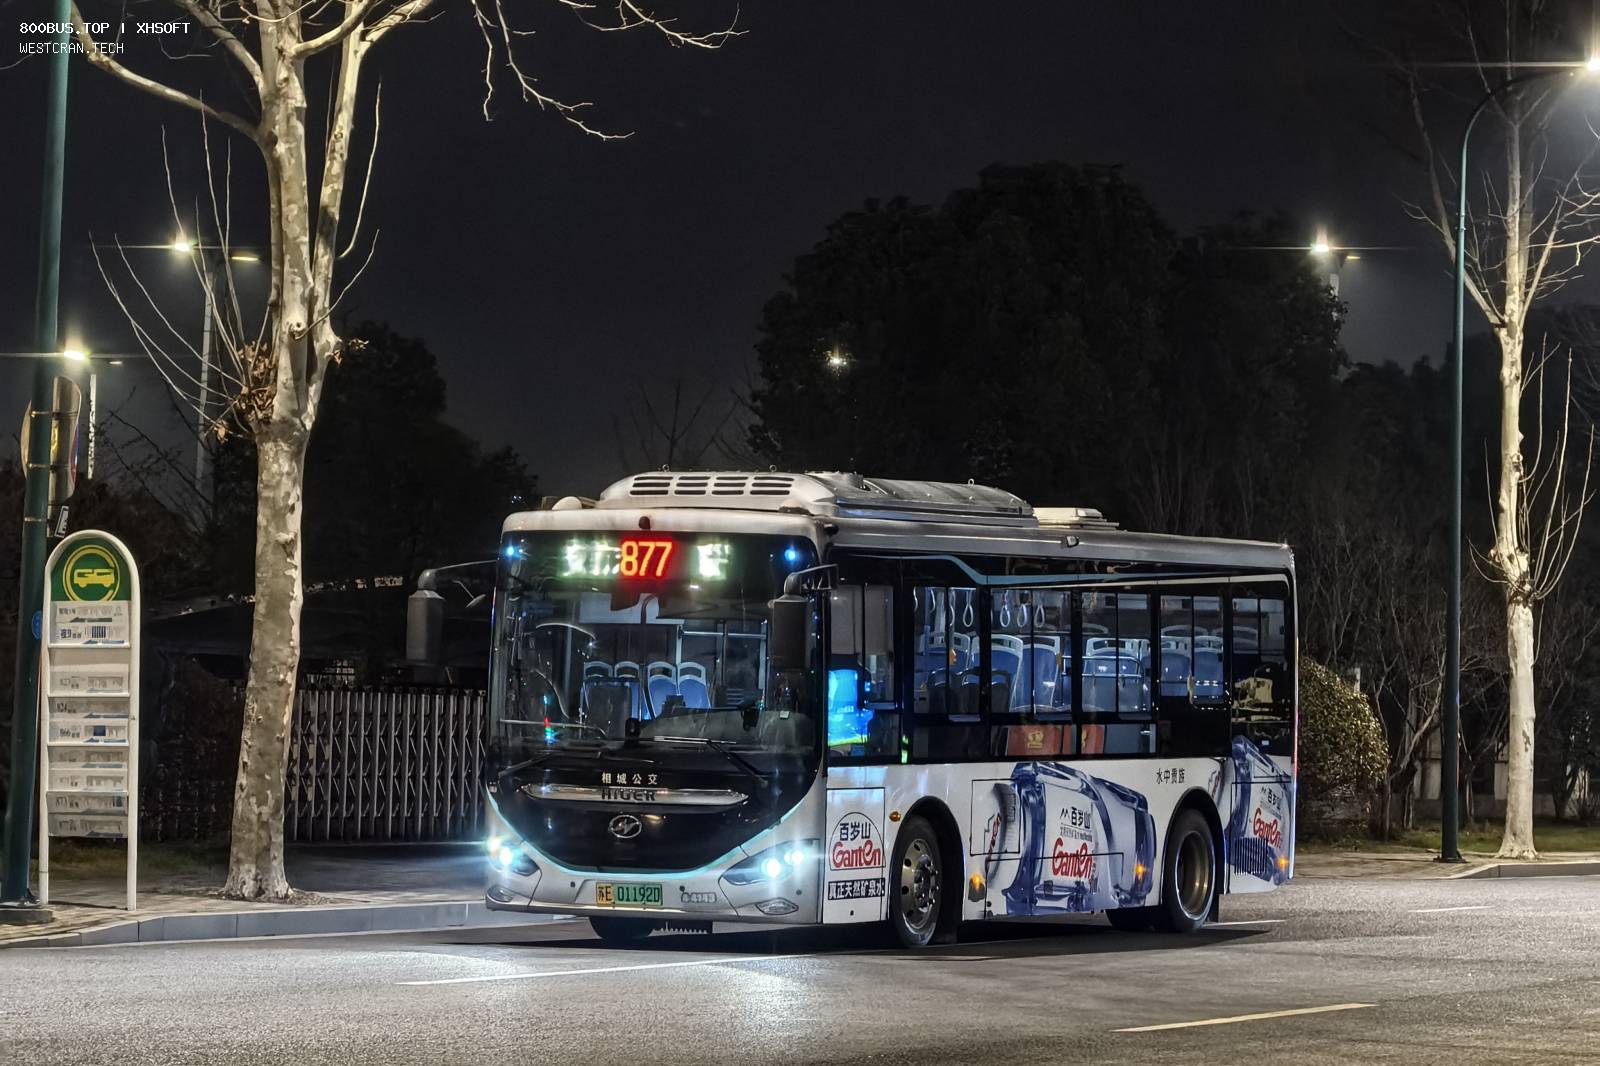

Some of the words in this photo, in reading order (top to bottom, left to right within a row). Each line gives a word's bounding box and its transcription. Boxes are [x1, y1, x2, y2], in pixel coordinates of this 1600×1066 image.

[620, 540, 673, 577] 877
[601, 772, 658, 785] 相城公交
[1156, 768, 1185, 784] 水中贵族
[839, 821, 871, 841] 百岁山
[829, 880, 885, 900] 真正天然矿泉水
